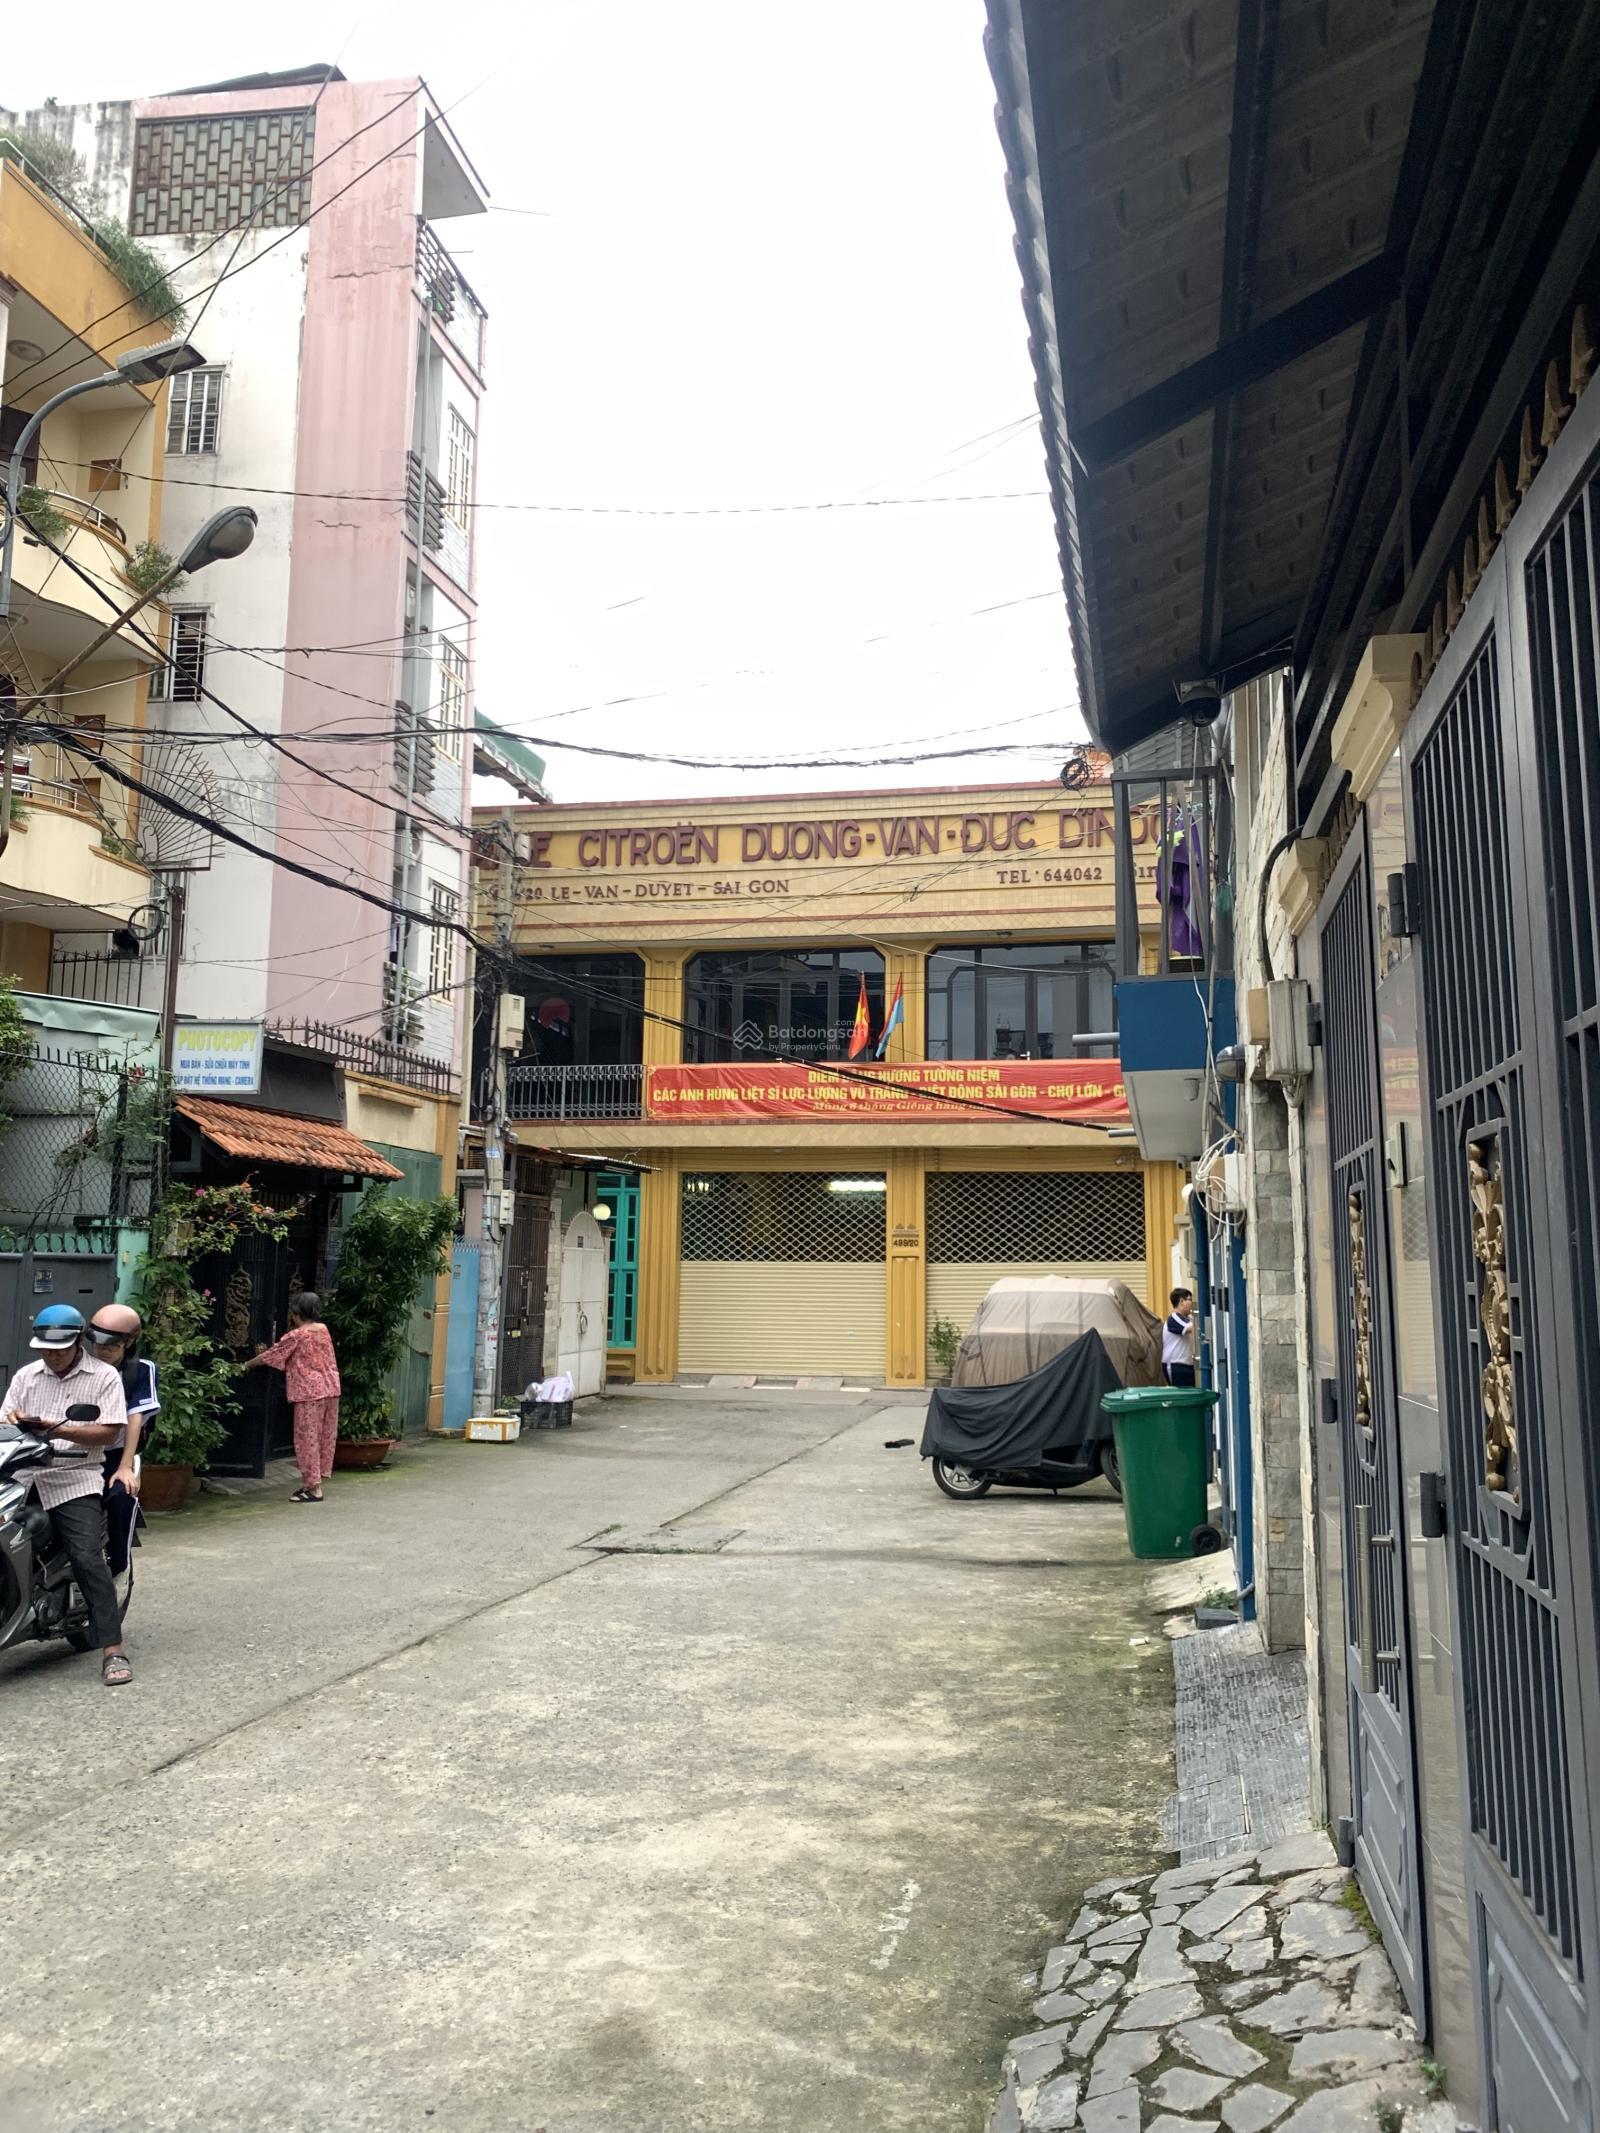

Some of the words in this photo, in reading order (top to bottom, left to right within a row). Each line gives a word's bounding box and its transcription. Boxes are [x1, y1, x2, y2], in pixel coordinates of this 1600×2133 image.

[578, 821, 720, 868] CITROËN
[749, 879, 789, 893] GON
[1043, 867, 1103, 882] 644042
[177, 1027, 257, 1051] PHOTOCOPY
[967, 1067, 1000, 1084] NIỆM
[653, 1087, 677, 1101] CÁC
[679, 1088, 705, 1101] ANH
[706, 1086, 739, 1101] HÙNG
[741, 1085, 765, 1102] LIỆT
[986, 1083, 1008, 1098] SÀI
[1009, 1082, 1037, 1098] GÒN
[1047, 1084, 1074, 1101] CHỢ
[1076, 1082, 1102, 1098] LỚN
